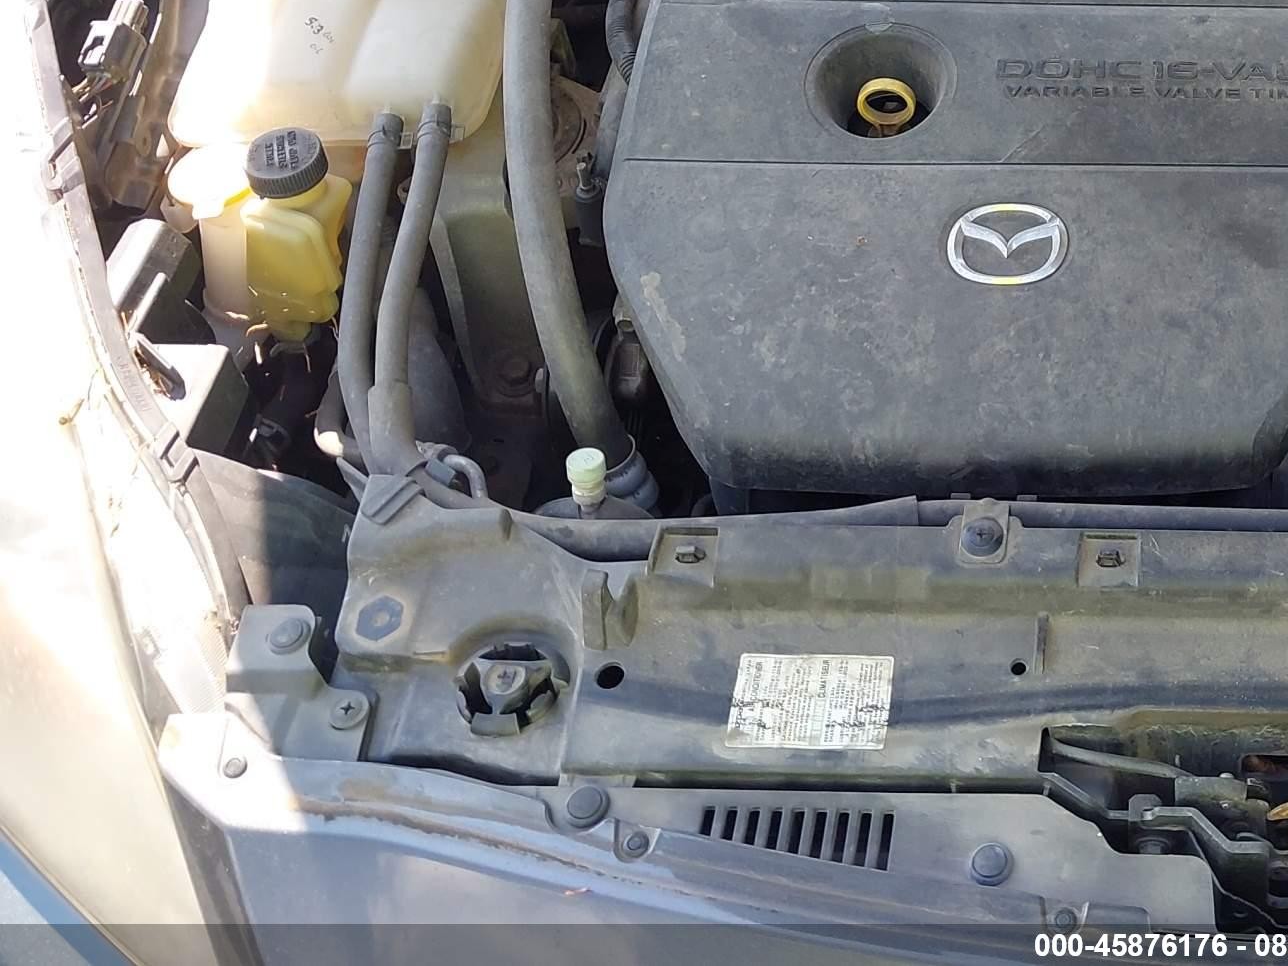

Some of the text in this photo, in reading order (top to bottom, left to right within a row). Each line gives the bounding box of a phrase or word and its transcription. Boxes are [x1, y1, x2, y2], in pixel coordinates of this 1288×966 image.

[996, 59, 1143, 80] DOHC
[1004, 85, 1146, 98] VARIABLE
[1153, 87, 1241, 99] VALVE
[817, 659, 830, 699] CLIMATISEUR
